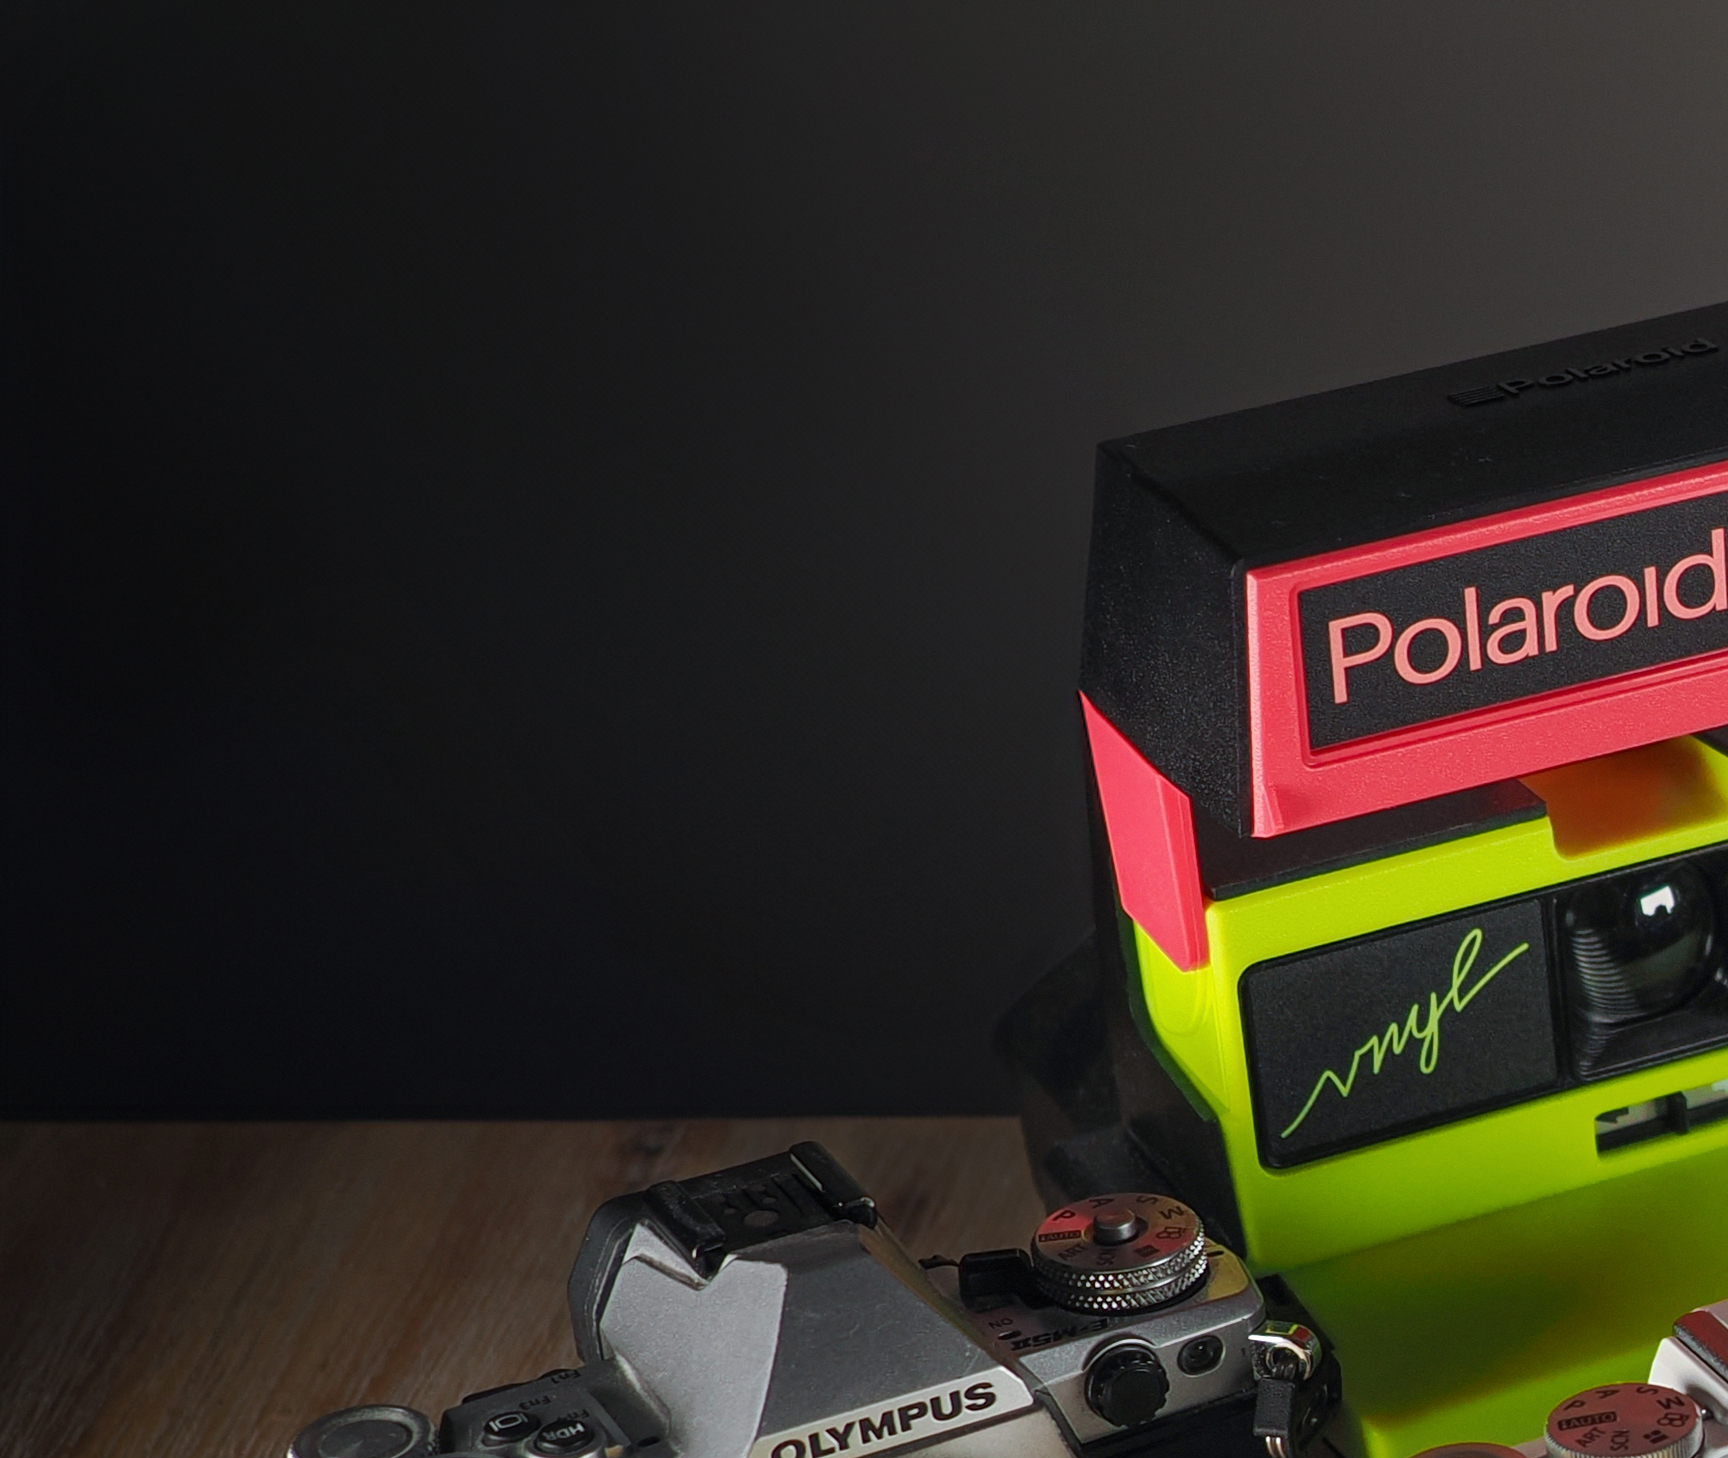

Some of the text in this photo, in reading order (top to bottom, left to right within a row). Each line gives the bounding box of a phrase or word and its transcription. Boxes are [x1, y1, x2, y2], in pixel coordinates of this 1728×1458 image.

[1497, 337, 1720, 395] Polaroid
[1327, 528, 1728, 703] Polaroid
[1052, 1209, 1076, 1222] P
[551, 1370, 580, 1385] Fn1
[1564, 1400, 1586, 1411] P
[1656, 1395, 1685, 1409] M
[543, 1423, 586, 1441] HDR
[1575, 1427, 1606, 1448] ART
